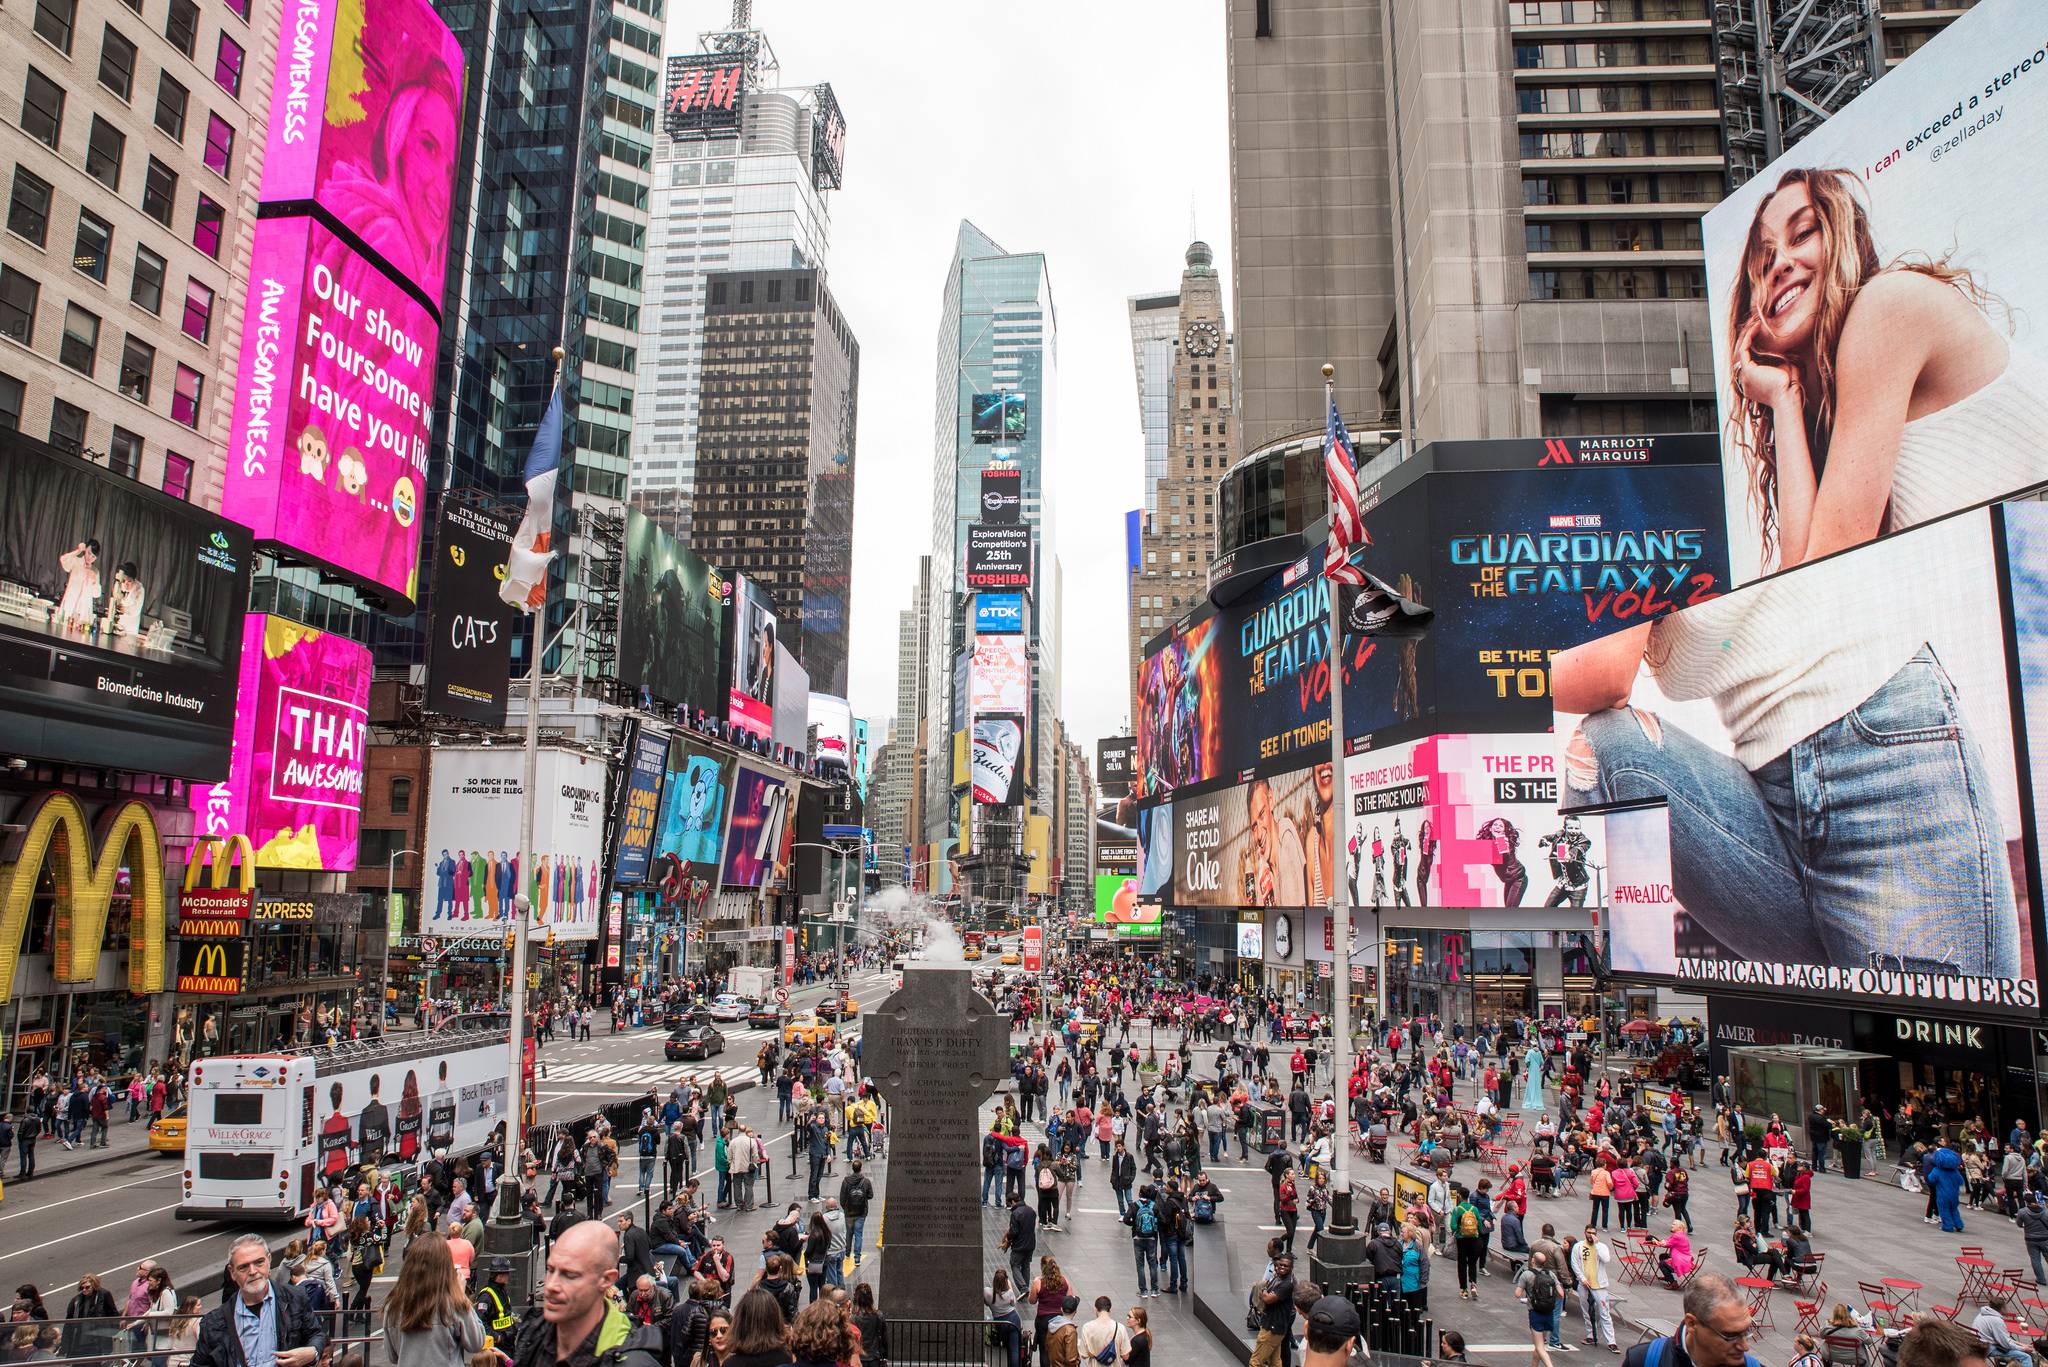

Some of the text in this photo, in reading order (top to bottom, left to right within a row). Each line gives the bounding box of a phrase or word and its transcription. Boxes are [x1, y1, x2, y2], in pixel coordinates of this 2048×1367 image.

[1865, 167, 1870, 180] I
[1874, 149, 1901, 174] can
[1905, 102, 1962, 152] exceed
[1968, 95, 1979, 110] a
[1929, 105, 2004, 163] @zelladay
[313, 263, 423, 367] Our show
[306, 312, 420, 417] Foursome
[300, 363, 407, 459] have you
[1580, 438, 1655, 449] MARRIOTT
[1580, 450, 1647, 461] MARQUIS
[989, 461, 1014, 470] 2017
[1359, 481, 1382, 501] ARRIOTT
[1359, 495, 1379, 513] ARQUIS
[459, 507, 508, 532] IT'S BACK AND
[1550, 515, 1601, 527] MARVEL STUDIOS
[476, 523, 496, 537] THAN
[972, 530, 1026, 538] ExploraVision
[972, 541, 1027, 549] Competition's
[1450, 529, 1706, 565] GUARDIANS
[986, 551, 1012, 560] 25th
[975, 563, 1022, 572] Anniversary
[1481, 566, 1504, 582] OF
[969, 574, 1029, 584] TOSHIBA
[1507, 563, 1694, 594] GALAXY
[1687, 572, 1724, 603] 2
[1470, 582, 1508, 598] THE
[991, 608, 1018, 617] TDK
[452, 614, 498, 650] CATS
[1253, 650, 1265, 672] OF
[1479, 650, 1502, 663] BE
[1507, 650, 1542, 663] THE
[1250, 672, 1266, 696] THE
[1487, 668, 1553, 698] TO
[97, 676, 204, 714] Biomedicine Industry
[1103, 750, 1126, 759] SONNEN
[1260, 736, 1279, 760] SEE
[1281, 732, 1292, 753] IT
[1106, 762, 1123, 771] SILVA
[1482, 755, 1522, 773] THE
[1350, 765, 1407, 791] THE PRICE YOU
[561, 785, 600, 804] GROUNDHOG
[1500, 780, 1557, 800] IS THE
[574, 801, 586, 814] DAY
[630, 789, 657, 811] COME
[1355, 787, 1417, 813] IS THE PRICE YOU
[1186, 805, 1219, 828] SHARE AN
[623, 828, 653, 848] AWAY
[1186, 828, 1220, 850] ICE COLD
[182, 897, 248, 907] McDonald's
[254, 902, 314, 919] EXPRESS
[191, 908, 236, 916] Restaurant
[442, 938, 501, 950] LUGGAG
[1676, 957, 2037, 1008] AMERICAN EAGLE OUTFITTERS
[891, 1037, 983, 1048] FRANCIS DUFFY
[1716, 1023, 1791, 1046] AMERICAN
[1895, 1017, 1984, 1049] DRINK
[461, 1084, 492, 1101] Back This
